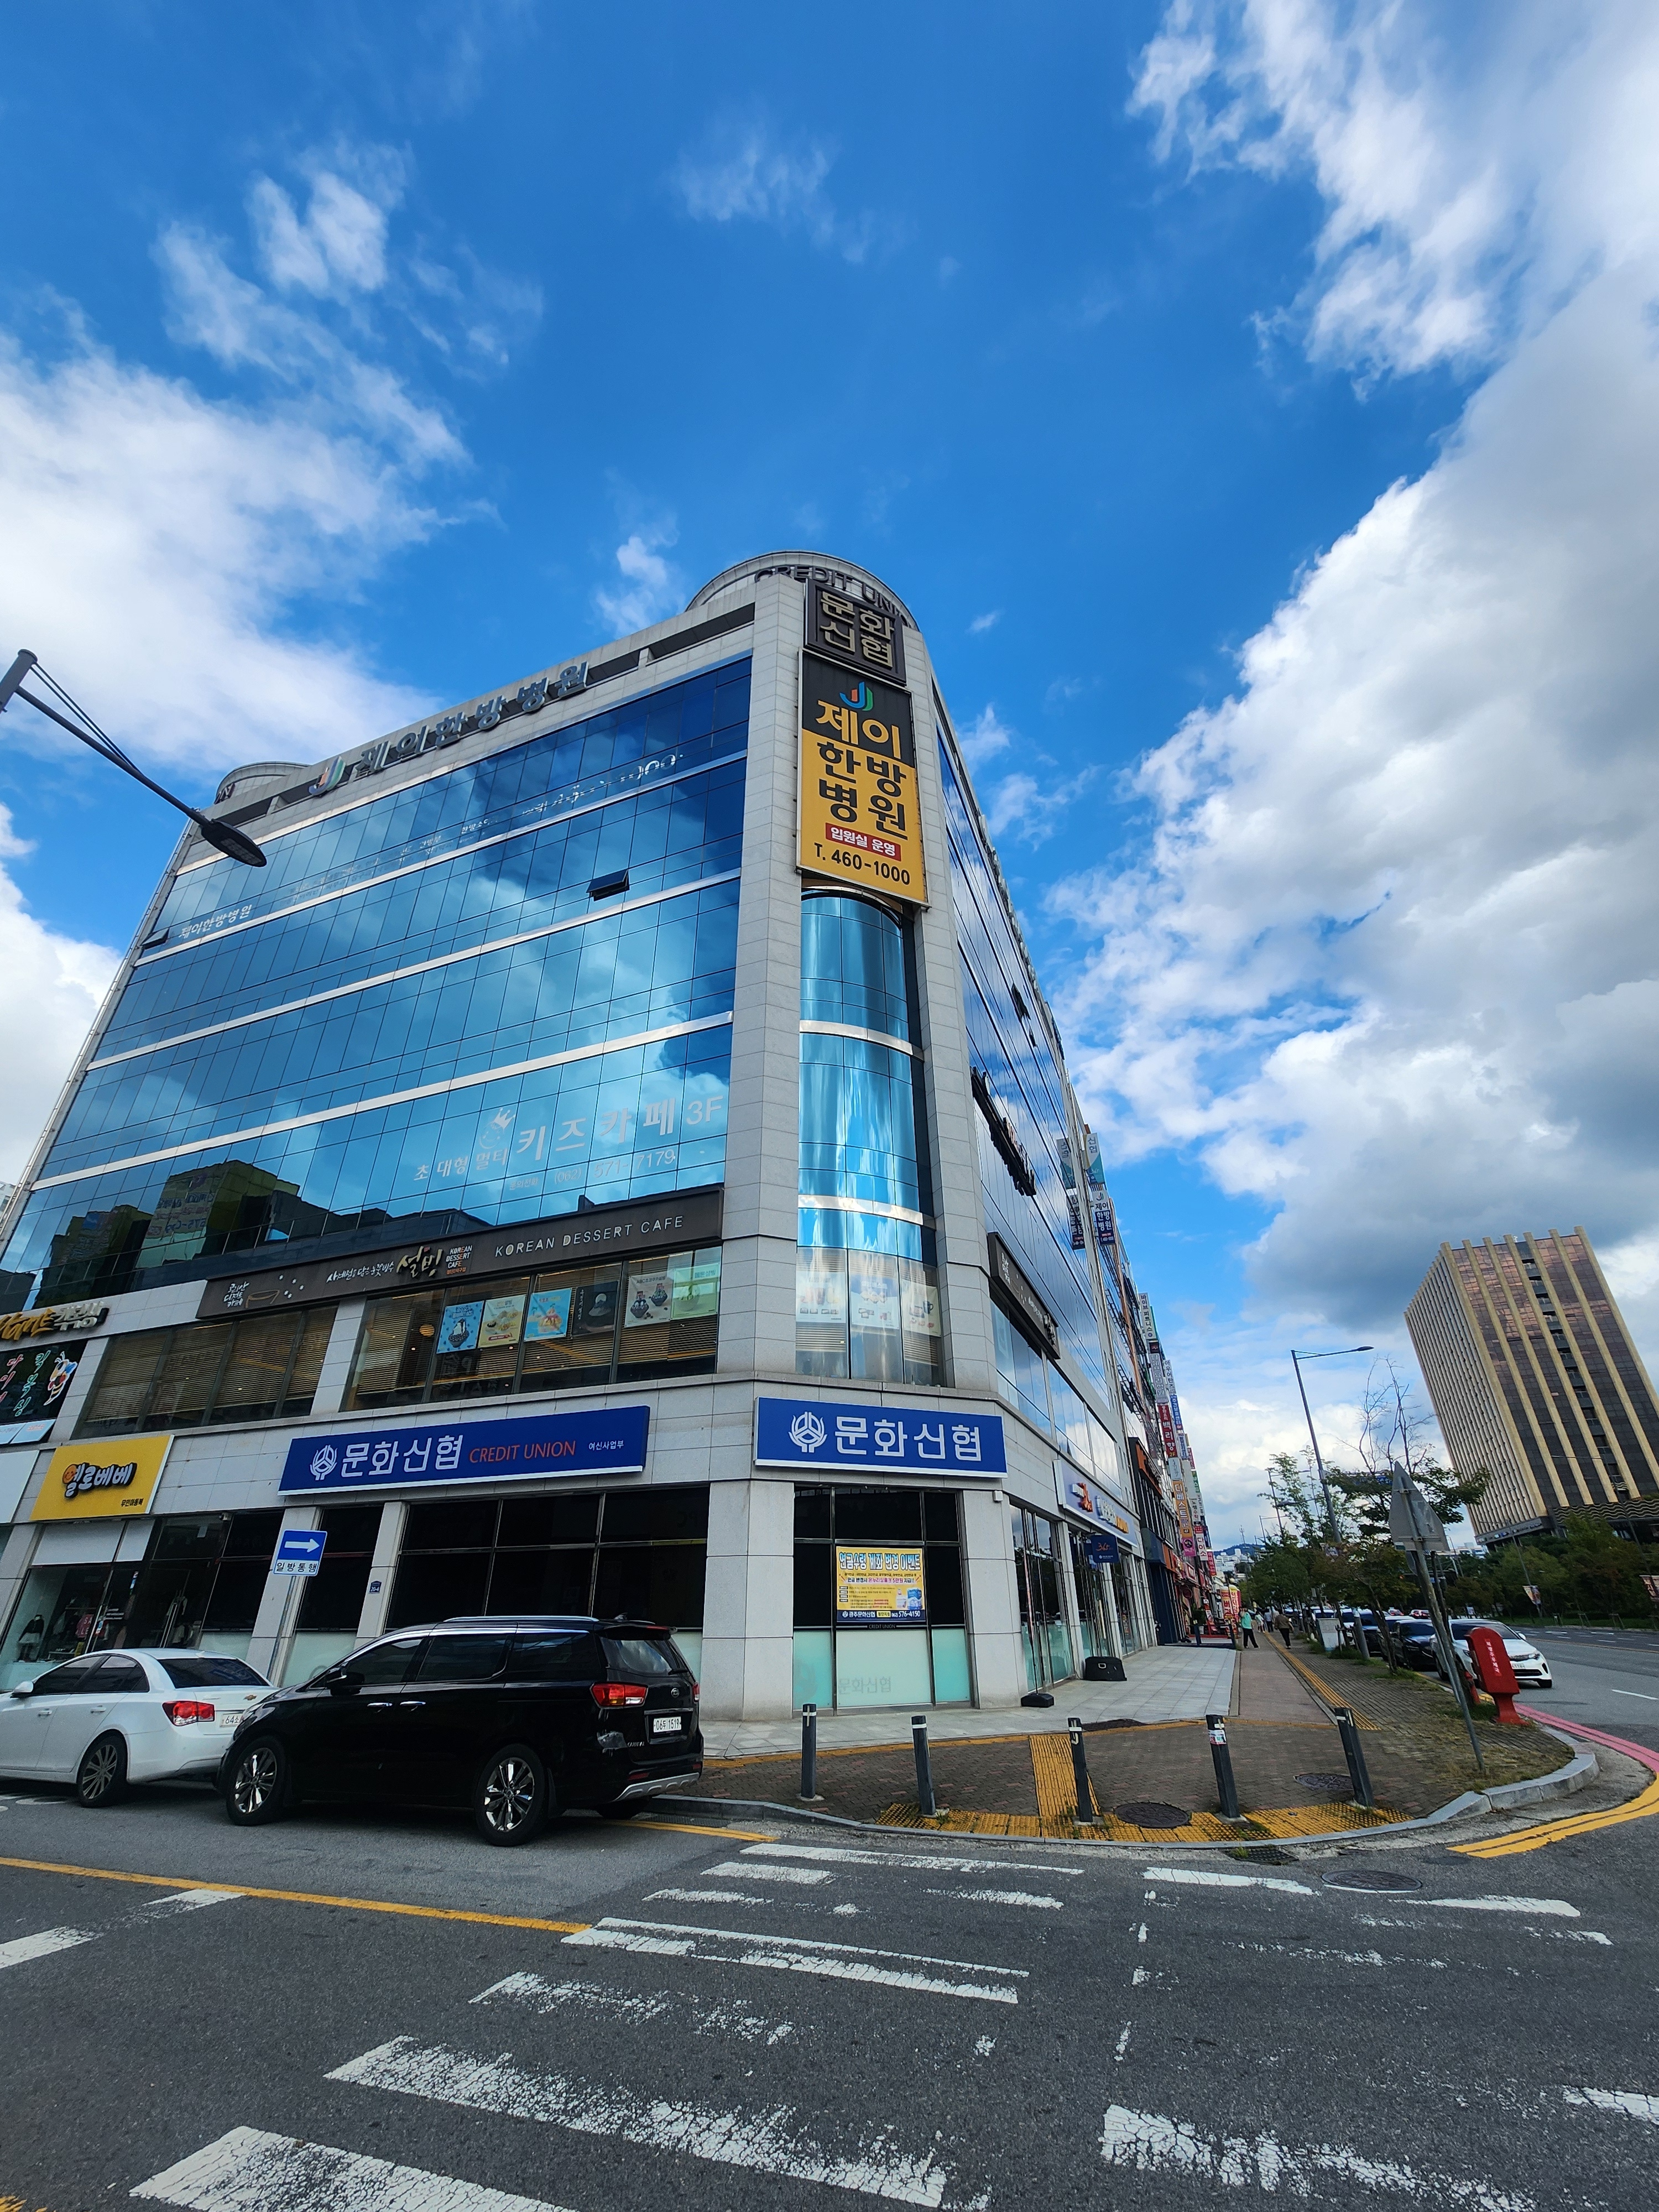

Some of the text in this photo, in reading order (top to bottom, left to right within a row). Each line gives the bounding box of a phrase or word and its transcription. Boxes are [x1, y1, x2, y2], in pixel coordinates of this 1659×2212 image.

[821, 591, 894, 641] 문화
[821, 622, 893, 670] 신협
[354, 661, 589, 780] 제이한방병원
[816, 699, 901, 759] 제이
[817, 741, 907, 798] 한방
[818, 778, 908, 841] 병원
[831, 826, 896, 858] 입원실 운영
[814, 842, 911, 886] T. 460-1000
[179, 904, 252, 939] 제이한방병원
[517, 1095, 724, 1161] 키즈카페 3F
[509, 1177, 539, 1191] 문의전화
[554, 1168, 582, 1185] (062)
[1095, 1201, 1109, 1211] 제이
[1097, 1211, 1110, 1222] 한방
[494, 1214, 684, 1258] KOREAN DESSERT CAFE
[1098, 1220, 1112, 1232] 병원
[396, 1245, 443, 1278] 설빙
[446, 1252, 471, 1262] DESSERT
[448, 1260, 462, 1269] CAFE
[450, 1245, 472, 1255] KOREAN
[227, 1298, 244, 1308] 카페
[1140, 1294, 1153, 1332] 바이브 피트니스
[834, 1415, 982, 1463] 문화신협
[1163, 1421, 1175, 1451] 백리향
[341, 1434, 624, 1478] 문화신협 CREDIT UNION 여신사업부
[1175, 1483, 1187, 1518] 디베스트
[839, 1552, 921, 1571] 연금수령 계좌 변경 이벤트
[1197, 1537, 1207, 1557] 다이소
[276, 1561, 317, 1574] 일방통행
[668, 1719, 680, 1729] 1519
